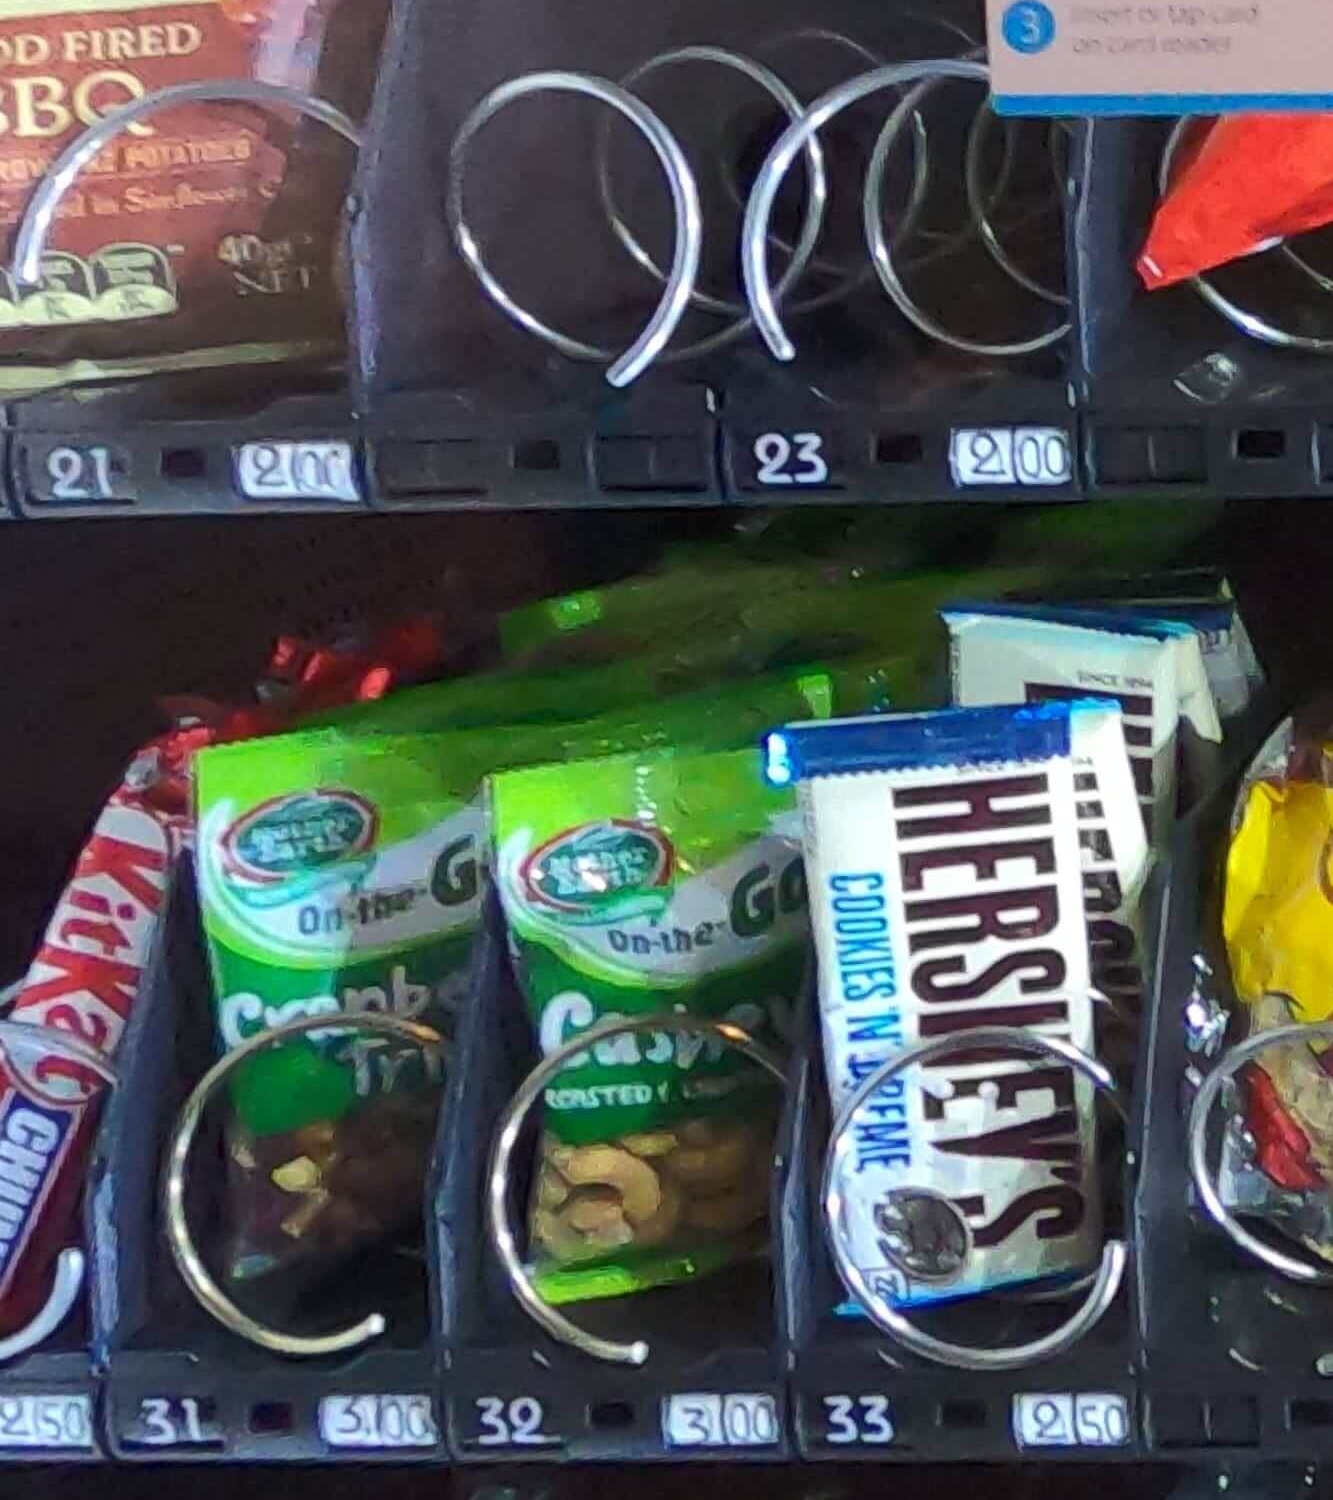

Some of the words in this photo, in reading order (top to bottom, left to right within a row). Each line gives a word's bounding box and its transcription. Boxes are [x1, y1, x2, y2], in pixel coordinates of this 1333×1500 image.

[61, 21, 202, 63] FIRED
[1019, 6, 1041, 45] 3
[49, 446, 114, 498] 21
[753, 431, 828, 485] 23
[828, 871, 897, 1002] COOKIES
[139, 1398, 204, 1445] 31
[476, 1396, 546, 1445] 32
[823, 1396, 894, 1443] 33
